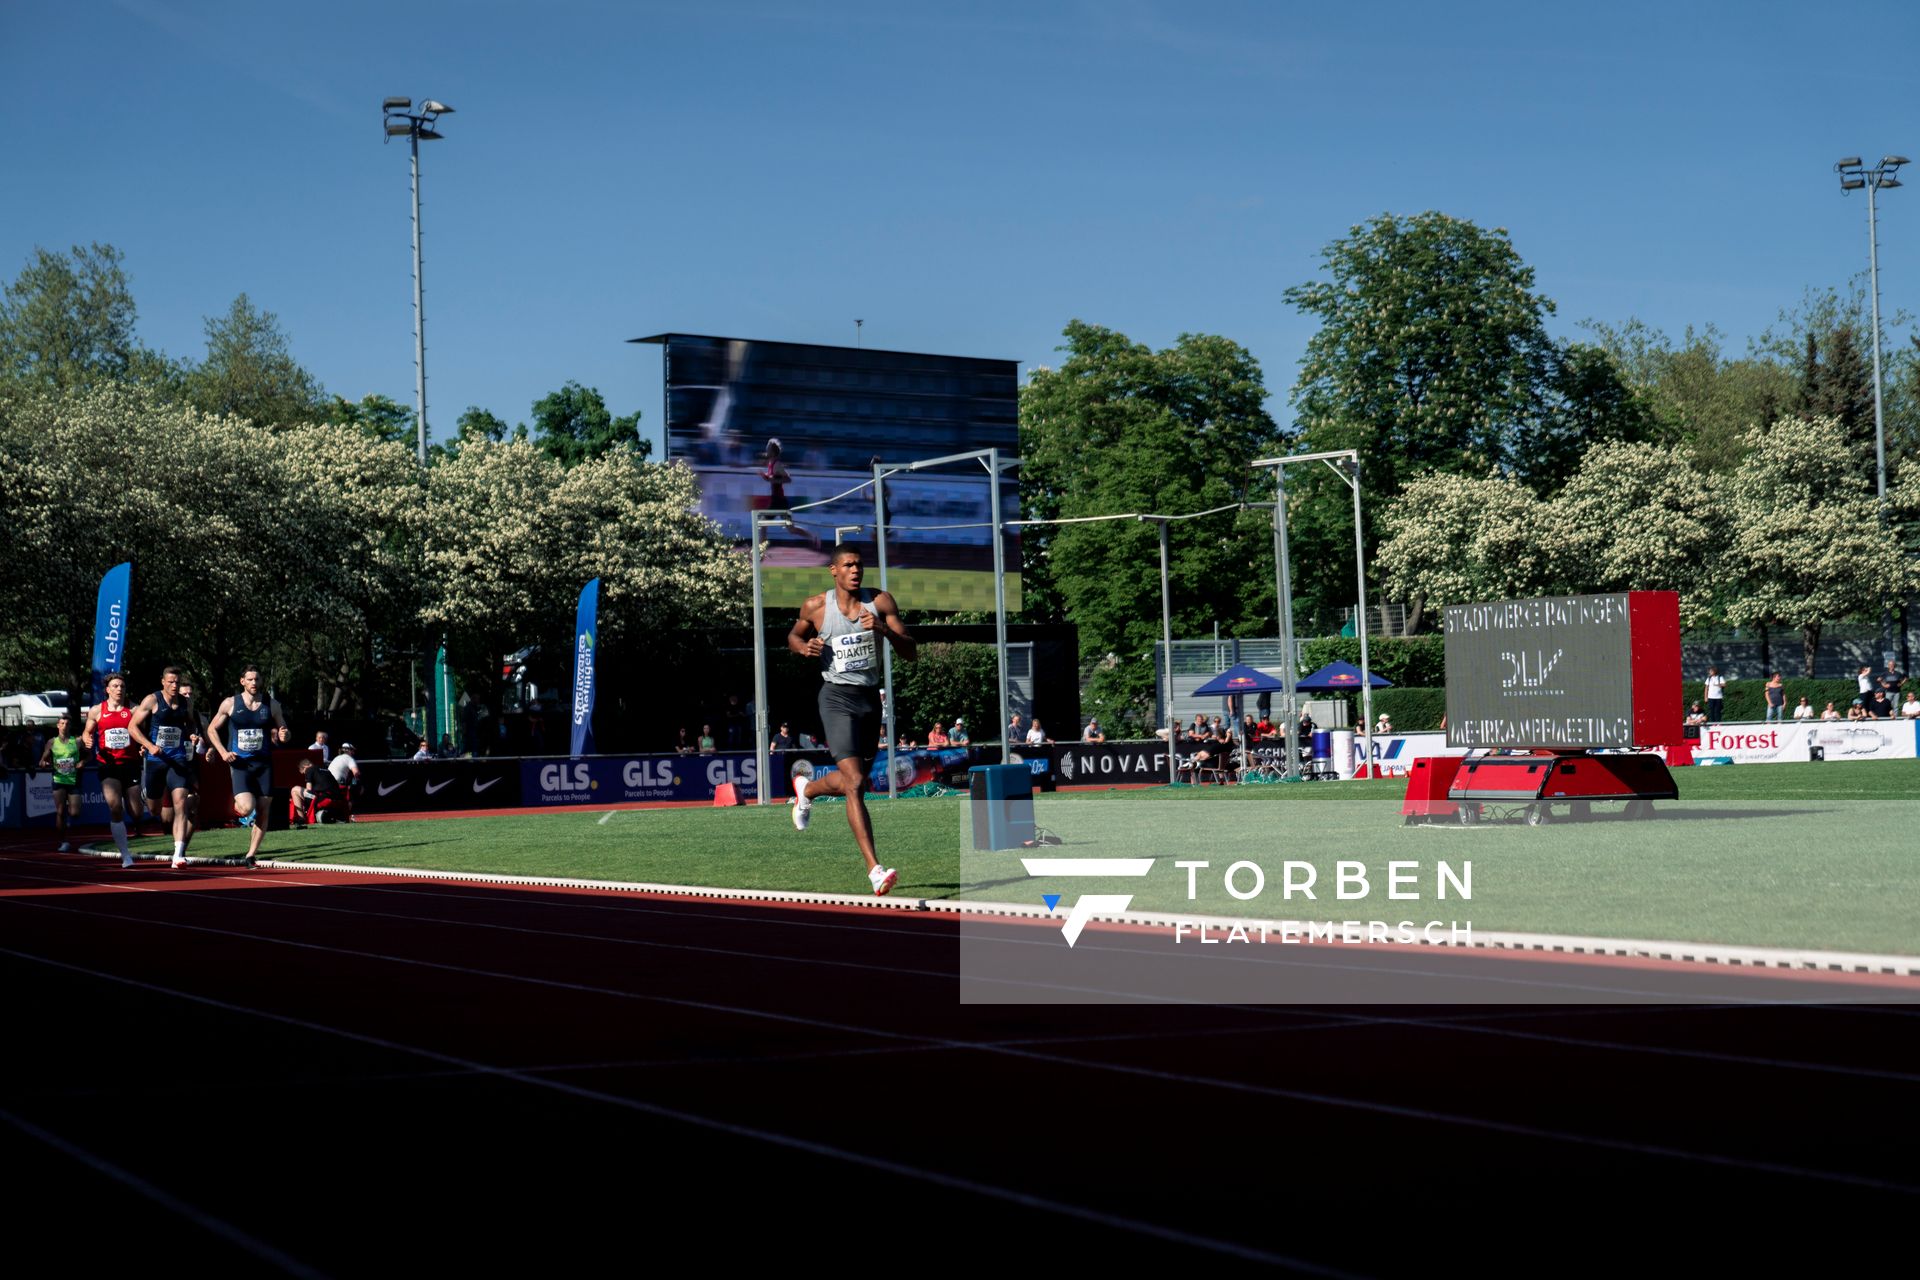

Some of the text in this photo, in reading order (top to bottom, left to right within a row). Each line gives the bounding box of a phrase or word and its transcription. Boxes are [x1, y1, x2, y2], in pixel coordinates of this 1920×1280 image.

[104, 599, 121, 663] Leben.
[841, 634, 863, 646] GLS
[835, 644, 874, 660] DIAKITE
[574, 634, 586, 725] Stadtwerke
[1707, 730, 1779, 751] Forest
